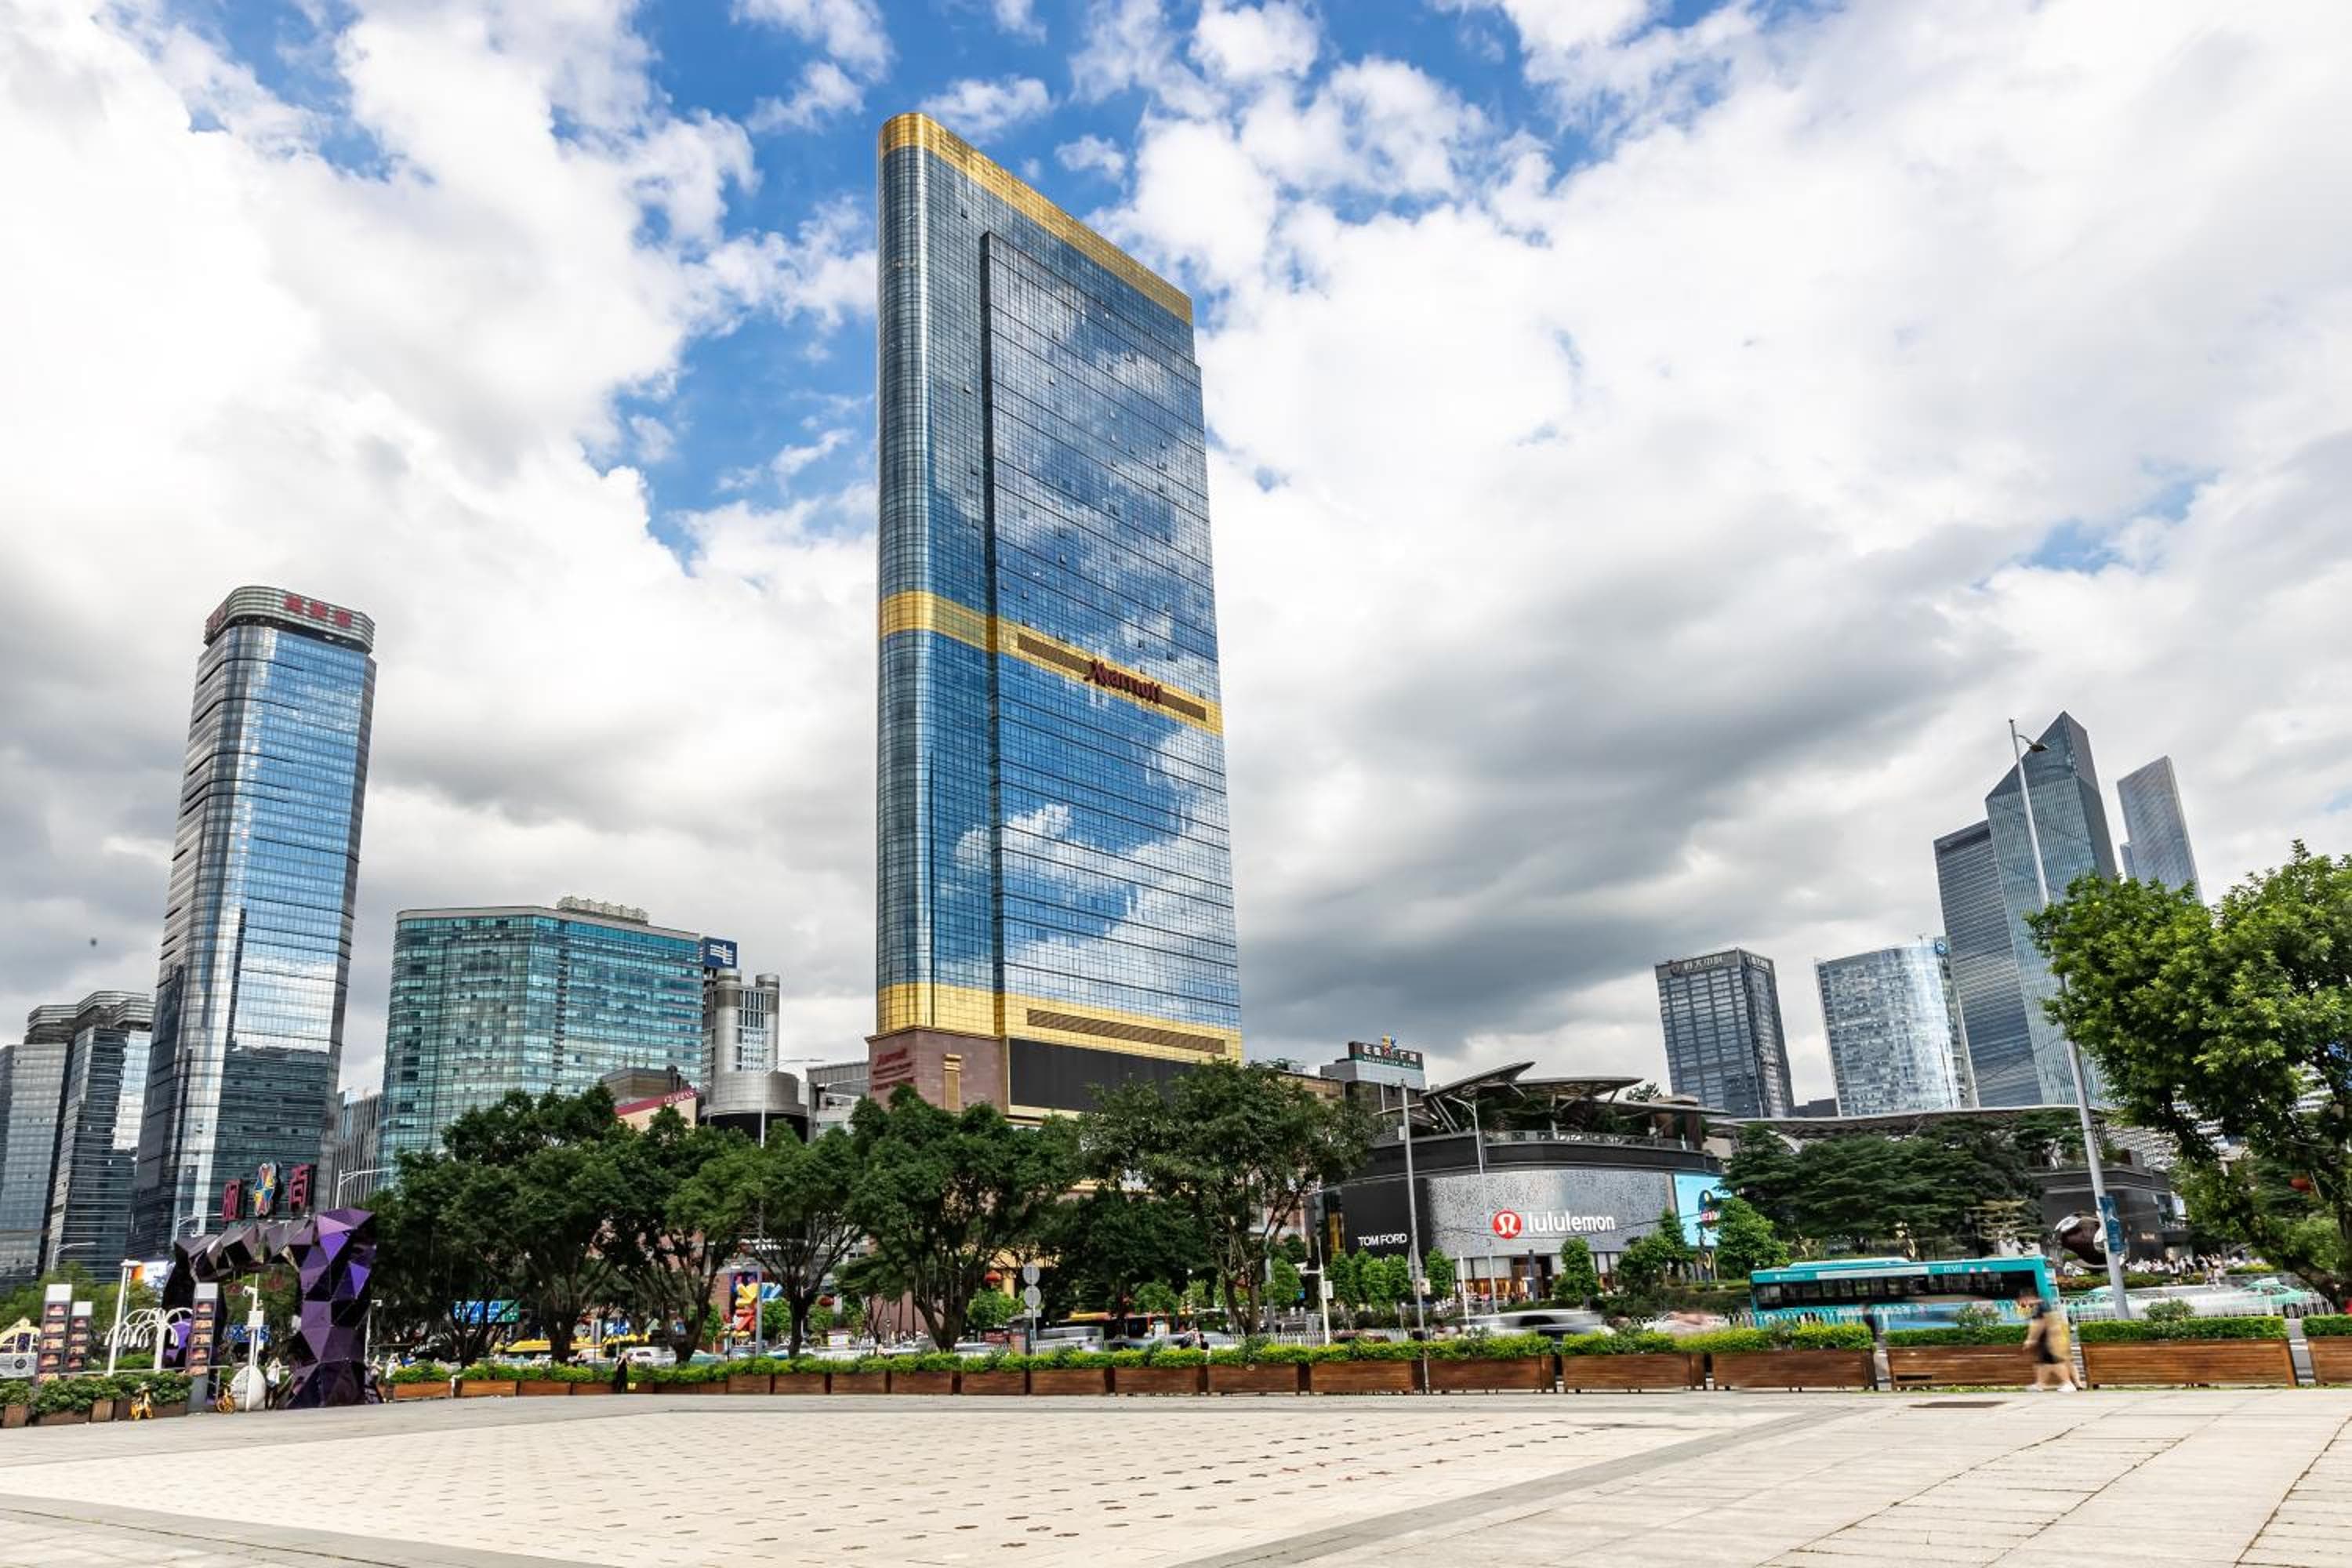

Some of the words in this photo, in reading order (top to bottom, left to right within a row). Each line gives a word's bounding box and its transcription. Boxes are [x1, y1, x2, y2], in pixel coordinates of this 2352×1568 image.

[1529, 1210, 1616, 1232] lululemon
[1357, 1235, 1379, 1247] TOM
[1380, 1233, 1407, 1246] FORD
